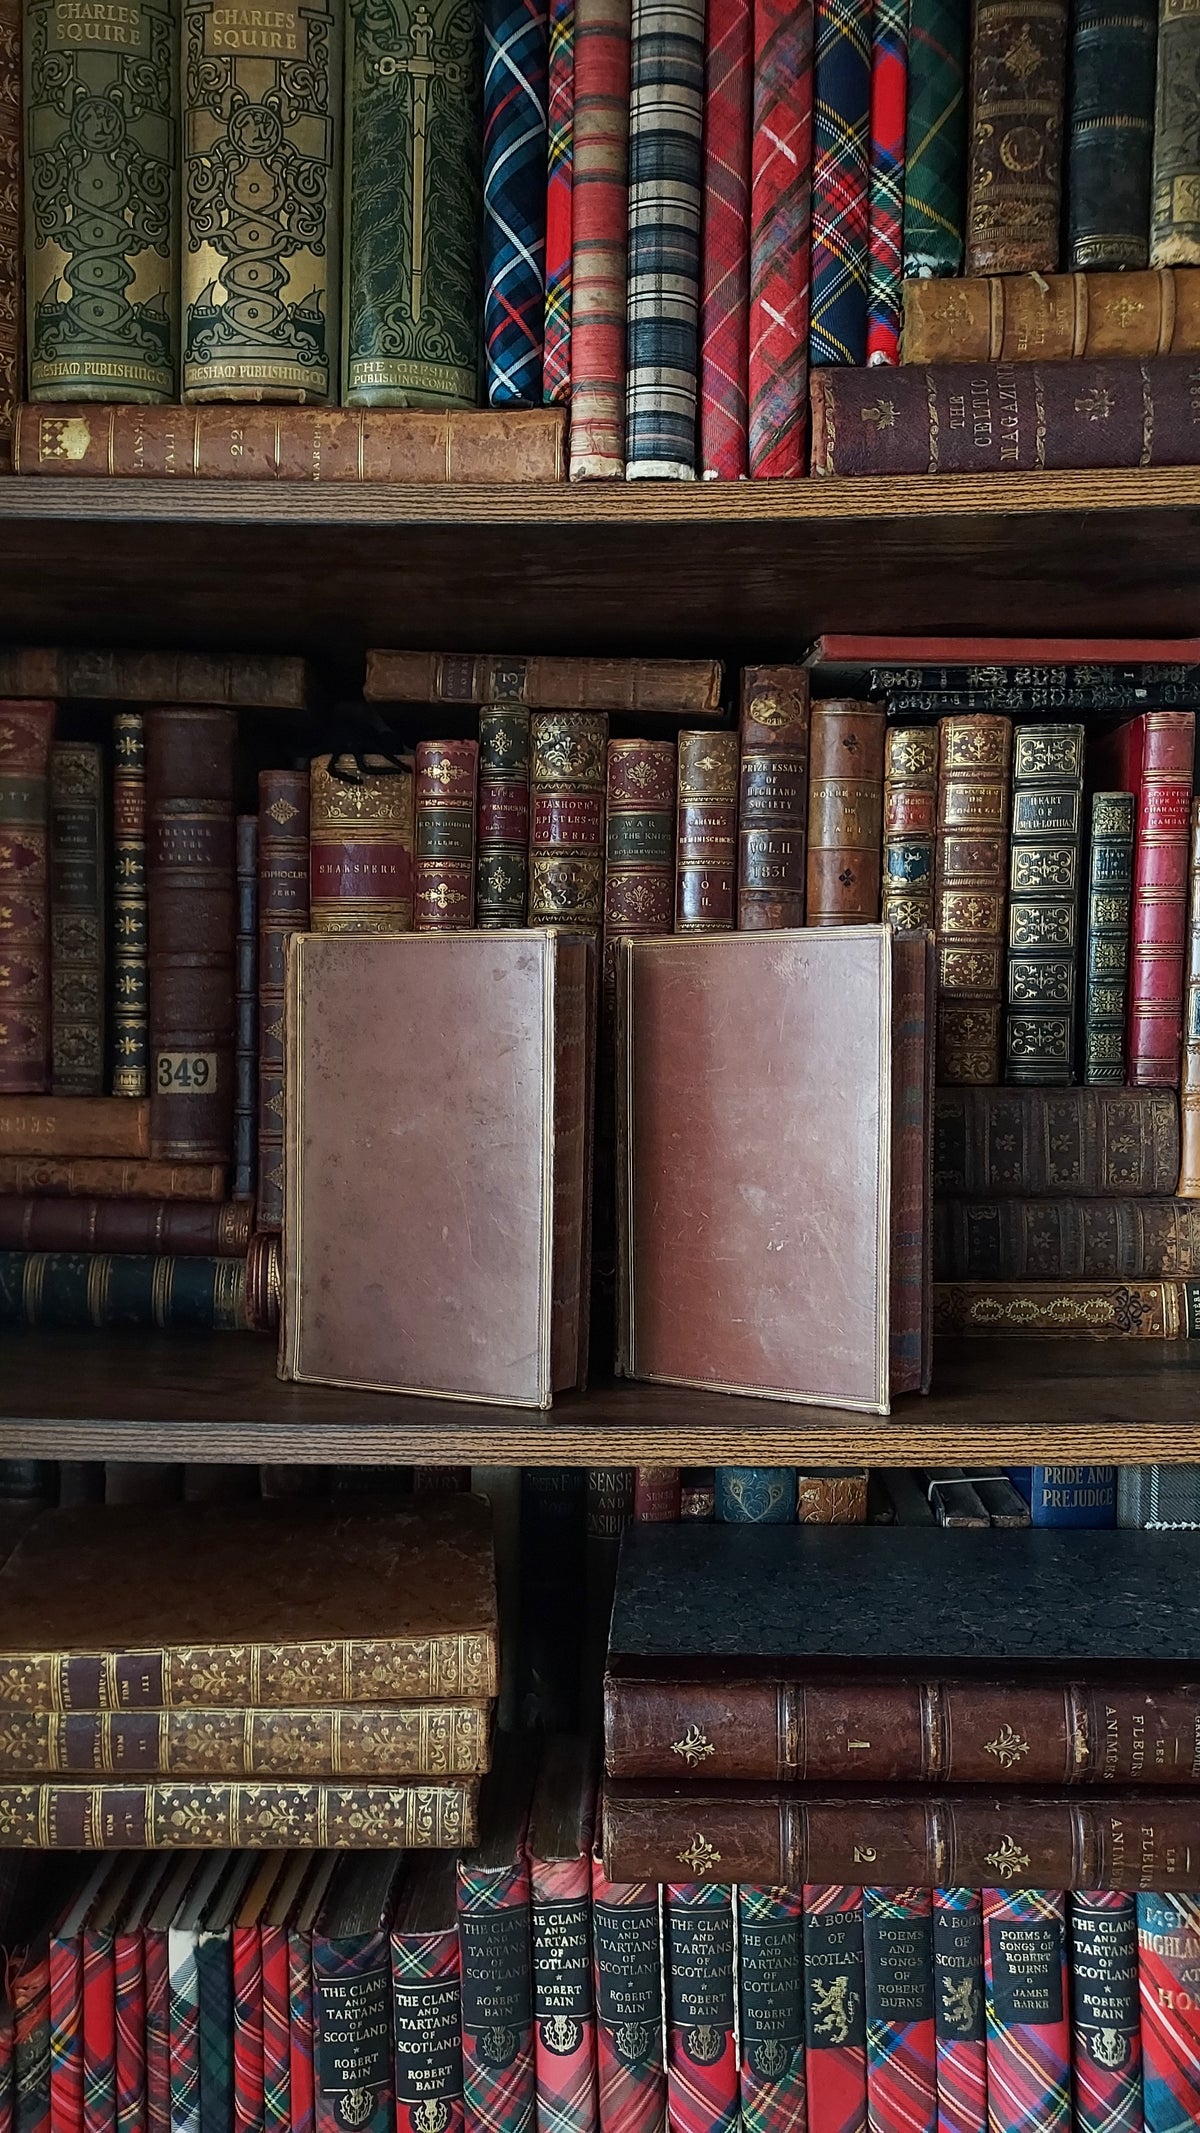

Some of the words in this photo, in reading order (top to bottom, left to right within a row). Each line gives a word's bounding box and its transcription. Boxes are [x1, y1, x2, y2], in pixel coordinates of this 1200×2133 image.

[56, 3, 140, 25] CHARLES
[212, 9, 296, 28] CHARLES
[56, 24, 142, 46] SQUIRE
[213, 29, 296, 49] SQUIRE
[84, 362, 156, 382] PUBLISHING
[353, 362, 384, 373] THE
[239, 366, 311, 382] PUBLISHING
[950, 395, 965, 430] THE
[970, 378, 992, 448] CELTIC
[230, 429, 244, 456] 22
[502, 672, 518, 685] 3
[742, 764, 768, 772] PRIZE
[772, 762, 804, 773] ESSAYS
[766, 776, 778, 784] OF
[747, 786, 797, 797] HIGHLAND
[748, 800, 793, 810] SOCIETY
[1030, 797, 1062, 806] HEART
[1038, 808, 1053, 817] OF
[624, 820, 656, 828] WAR
[536, 831, 596, 840] GOSPELS
[624, 832, 641, 840] THE
[319, 864, 396, 874] SHAKSPERE
[752, 864, 787, 878] 1831
[158, 1058, 209, 1088] 349
[1043, 1466, 1083, 1485] PRIDE
[1087, 1466, 1112, 1483] AND
[588, 1471, 632, 1493] SENSE
[598, 1497, 624, 1509] AND
[1042, 1488, 1113, 1507] PREJUDICE
[116, 1735, 124, 1758] TOM
[1130, 1715, 1144, 1776] FLEURS
[1156, 1740, 1164, 1764] LES
[106, 1814, 114, 1838] TOM
[854, 1846, 877, 1863] 2
[1140, 1827, 1154, 1888] FLEURS
[1166, 1848, 1175, 1872] LES
[548, 1911, 588, 1926] CLANS
[596, 1914, 619, 1930] THE
[808, 1916, 820, 1928] A
[824, 1910, 863, 1927] BOOK
[938, 1915, 948, 1928] A
[464, 1922, 488, 1936] THE
[544, 1926, 567, 1936] AND
[670, 1918, 694, 1932] THE
[697, 1918, 732, 1932] CLAN
[1072, 1917, 1095, 1932] THE
[1098, 1918, 1136, 1934] CLANS
[486, 1935, 508, 1944] AND
[532, 1934, 587, 1948] ARTANS
[618, 1932, 640, 1940] AND
[692, 1934, 715, 1942] AND
[828, 1932, 846, 1944] OF
[878, 1930, 924, 1940] POEMS
[1000, 1930, 1040, 1940] POEMS
[1042, 1932, 1052, 1940] &
[1094, 1934, 1117, 1944] AND
[600, 1938, 658, 1953] TARTANS
[954, 1936, 971, 1948] OF
[1000, 1942, 1035, 1950] SONGS
[1040, 1942, 1055, 1951] OF
[468, 1942, 526, 1958] TARTANS
[550, 1948, 564, 1958] OF
[672, 1942, 732, 1956] TARTANS
[758, 1948, 782, 1956] AND
[888, 1944, 914, 1954] AND
[1074, 1940, 1135, 1958] TARTANS
[622, 1954, 636, 1964] OF
[696, 1957, 711, 1966] OF
[880, 1958, 924, 1966] SONGS
[1006, 1952, 1051, 1962] ROBERT
[1098, 1958, 1114, 1968] OF
[490, 1960, 504, 1968] OF
[532, 1957, 590, 1970] COTLAND
[1008, 1964, 1048, 1974] BURNS
[763, 1972, 778, 1980] OF
[894, 1971, 911, 1980] OF
[1074, 1964, 1138, 1981] SCOTLAND
[321, 1986, 346, 1998] THE
[350, 1978, 388, 1997] CLANS
[536, 1984, 582, 1995] ROBERT
[878, 1984, 926, 1994] ROBERT
[1012, 1988, 1049, 1997] JAMES
[396, 1994, 419, 2007] THE
[422, 1990, 460, 2006] CLANS
[476, 1994, 520, 2006] ROBERT
[544, 1996, 574, 2006] BAIN
[610, 1990, 653, 2002] ROBERT
[680, 1994, 727, 2004] ROBERT
[1083, 1993, 1131, 2006] ROBERT
[344, 1998, 367, 2007] AND
[616, 2003, 646, 2014] BAIN
[880, 1998, 923, 2008] BURNS
[326, 2000, 385, 2020] TARTANS
[416, 2008, 440, 2017] AND
[484, 2007, 513, 2018] BAIN
[689, 2006, 719, 2016] BAIN
[748, 2008, 794, 2020] ROBERT
[1092, 2008, 1124, 2020] BAIN
[350, 2022, 363, 2030] OF
[400, 2014, 458, 2030] TARTANS
[756, 2020, 786, 2030] BAIN
[324, 2023, 388, 2043] SCOTLAND
[422, 2030, 436, 2040] OF
[398, 2036, 462, 2054] SCOTLAND
[334, 2052, 380, 2069] ROBERT
[342, 2067, 372, 2080] BAIN
[407, 2065, 453, 2080] ROBERT
[416, 2078, 446, 2092] BAIN
